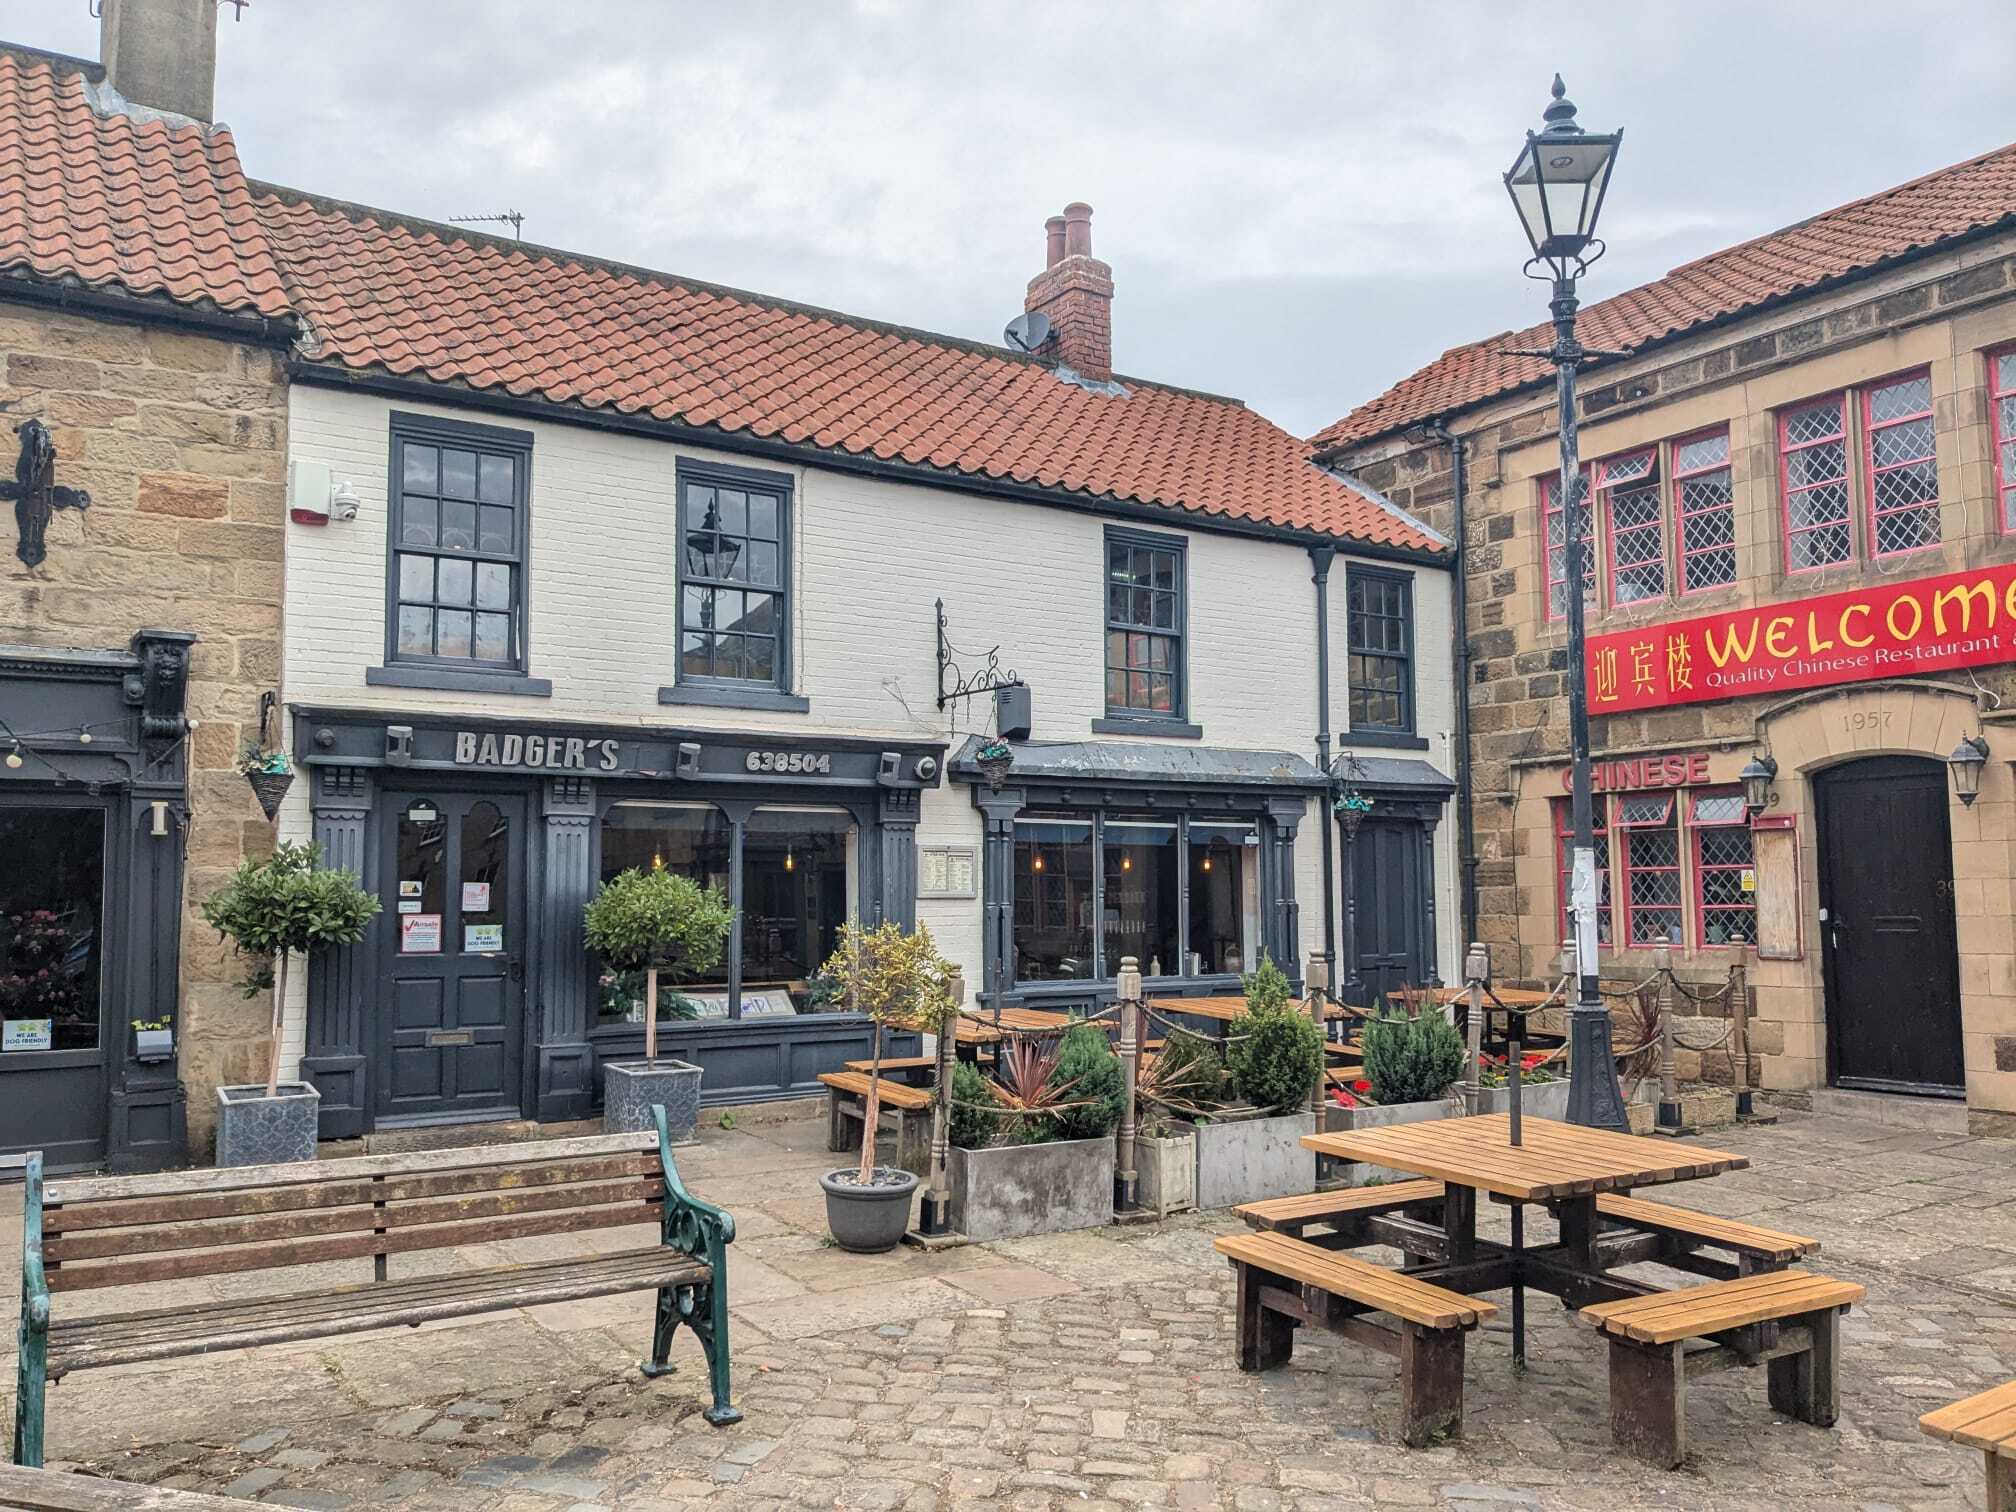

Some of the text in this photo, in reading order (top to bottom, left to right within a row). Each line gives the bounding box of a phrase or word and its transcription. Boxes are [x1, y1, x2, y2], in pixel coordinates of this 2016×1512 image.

[1593, 633, 1693, 702] 迎宾楼
[1706, 665, 1776, 688] Quality
[1783, 653, 1869, 677] Chinese
[1875, 634, 2000, 663] Restaurant
[1844, 711, 1893, 732] 1957
[746, 751, 831, 773] 638504
